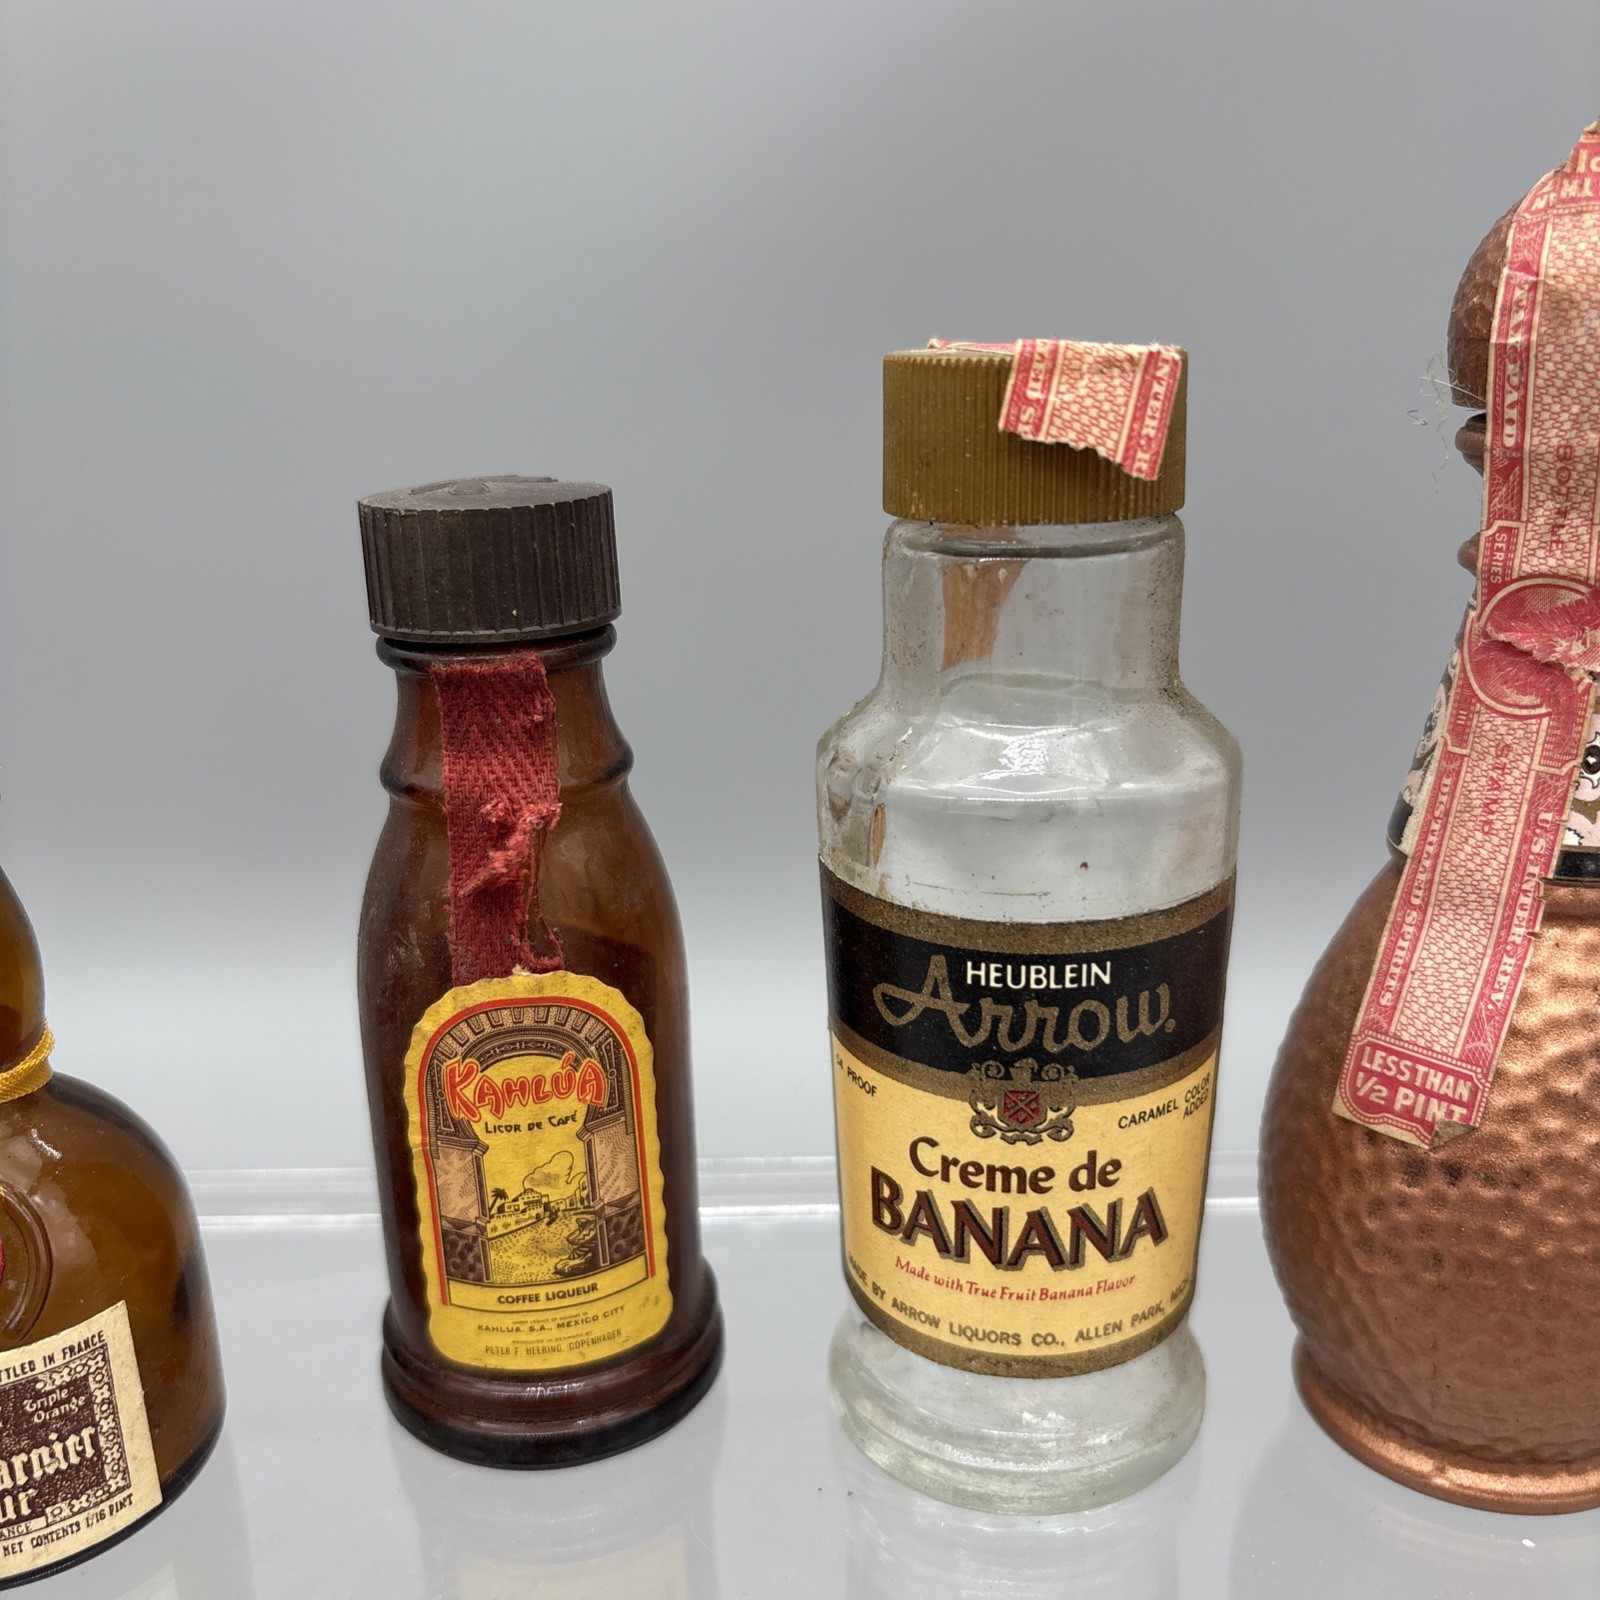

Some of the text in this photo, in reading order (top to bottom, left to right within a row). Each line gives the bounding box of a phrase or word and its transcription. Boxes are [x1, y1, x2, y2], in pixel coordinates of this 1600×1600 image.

[1490, 533, 1508, 584] SERIES
[966, 961, 1111, 990] HEUBLEIN
[444, 1051, 607, 1123] KAHLÚA
[847, 1066, 878, 1097] PROOF
[1361, 1046, 1472, 1103] LESS THAN
[1117, 1072, 1211, 1129] CARAMEL COLOR
[1182, 1087, 1209, 1119] ADDED
[909, 1136, 1122, 1194] Creme de
[871, 1165, 1169, 1272] BANANA
[497, 1282, 599, 1304] COFFEE LIQUEUR
[894, 1255, 1136, 1301] Made with True Fruit Banana Flavor
[556, 1314, 600, 1329] MEXICO
[603, 1304, 626, 1318] CITY
[872, 1280, 887, 1300] BY
[891, 1297, 941, 1329] ARROW
[949, 1321, 1022, 1346] LIQUORS
[1031, 1332, 1066, 1347] CO.,
[1074, 1319, 1123, 1343] ALLEN
[1130, 1300, 1165, 1327] PARK,
[42, 1352, 56, 1368] IN
[61, 1329, 106, 1360] FRANCE
[485, 1345, 511, 1356] PETER
[569, 1327, 623, 1351] COPENHAGEN
[23, 1388, 69, 1411] Triple
[34, 1396, 86, 1423] Orange
[2, 1541, 24, 1557] NET
[30, 1520, 82, 1549] CONTENTS
[108, 1492, 134, 1516] PINT
